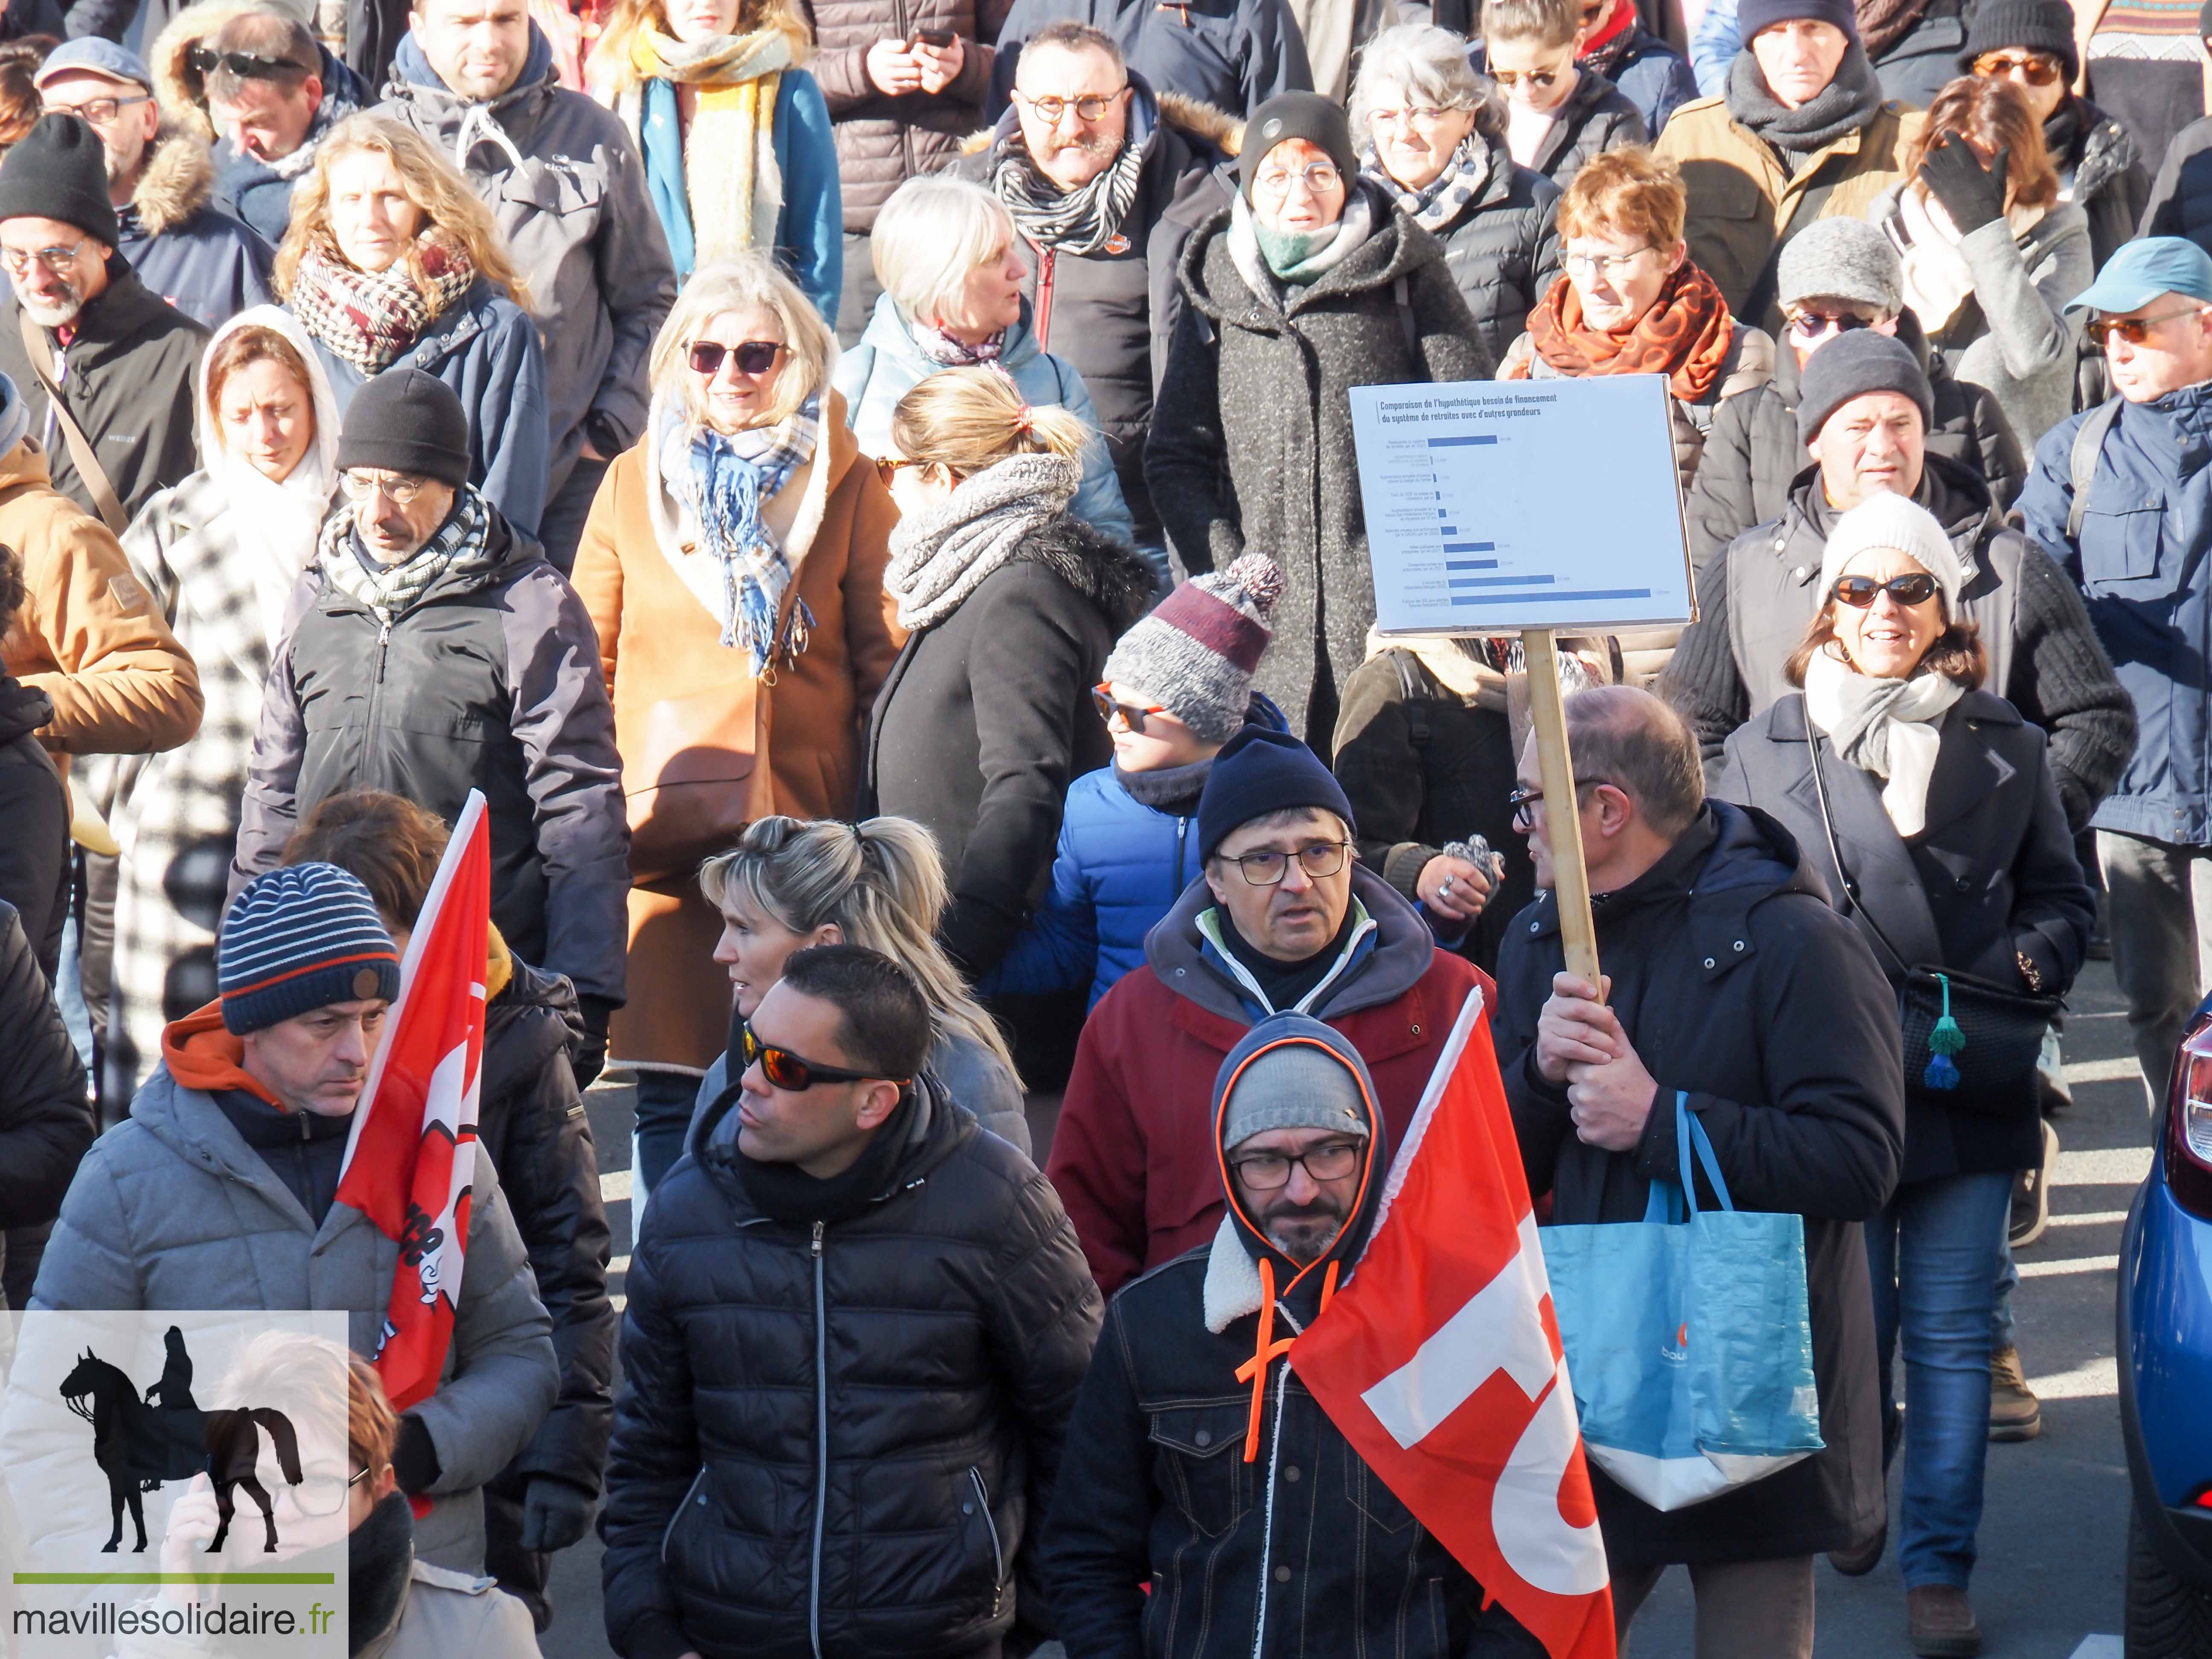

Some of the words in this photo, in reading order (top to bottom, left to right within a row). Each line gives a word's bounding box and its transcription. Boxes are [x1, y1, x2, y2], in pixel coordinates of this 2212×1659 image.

[1380, 400, 1422, 411] Comparaison
[1424, 399, 1432, 408] de
[1434, 398, 1480, 408] l'hypothétique
[1482, 396, 1503, 405] besoin
[1505, 395, 1513, 404] de
[1515, 394, 1557, 403] financement
[1382, 414, 1390, 423] du
[1392, 413, 1419, 424] système
[1421, 412, 1429, 421] de
[1431, 411, 1459, 420] retraites
[1461, 411, 1476, 419] avec
[1479, 410, 1505, 419] d'autres
[1506, 407, 1541, 419] grandeurs
[1662, 1345, 1687, 1360] bou
